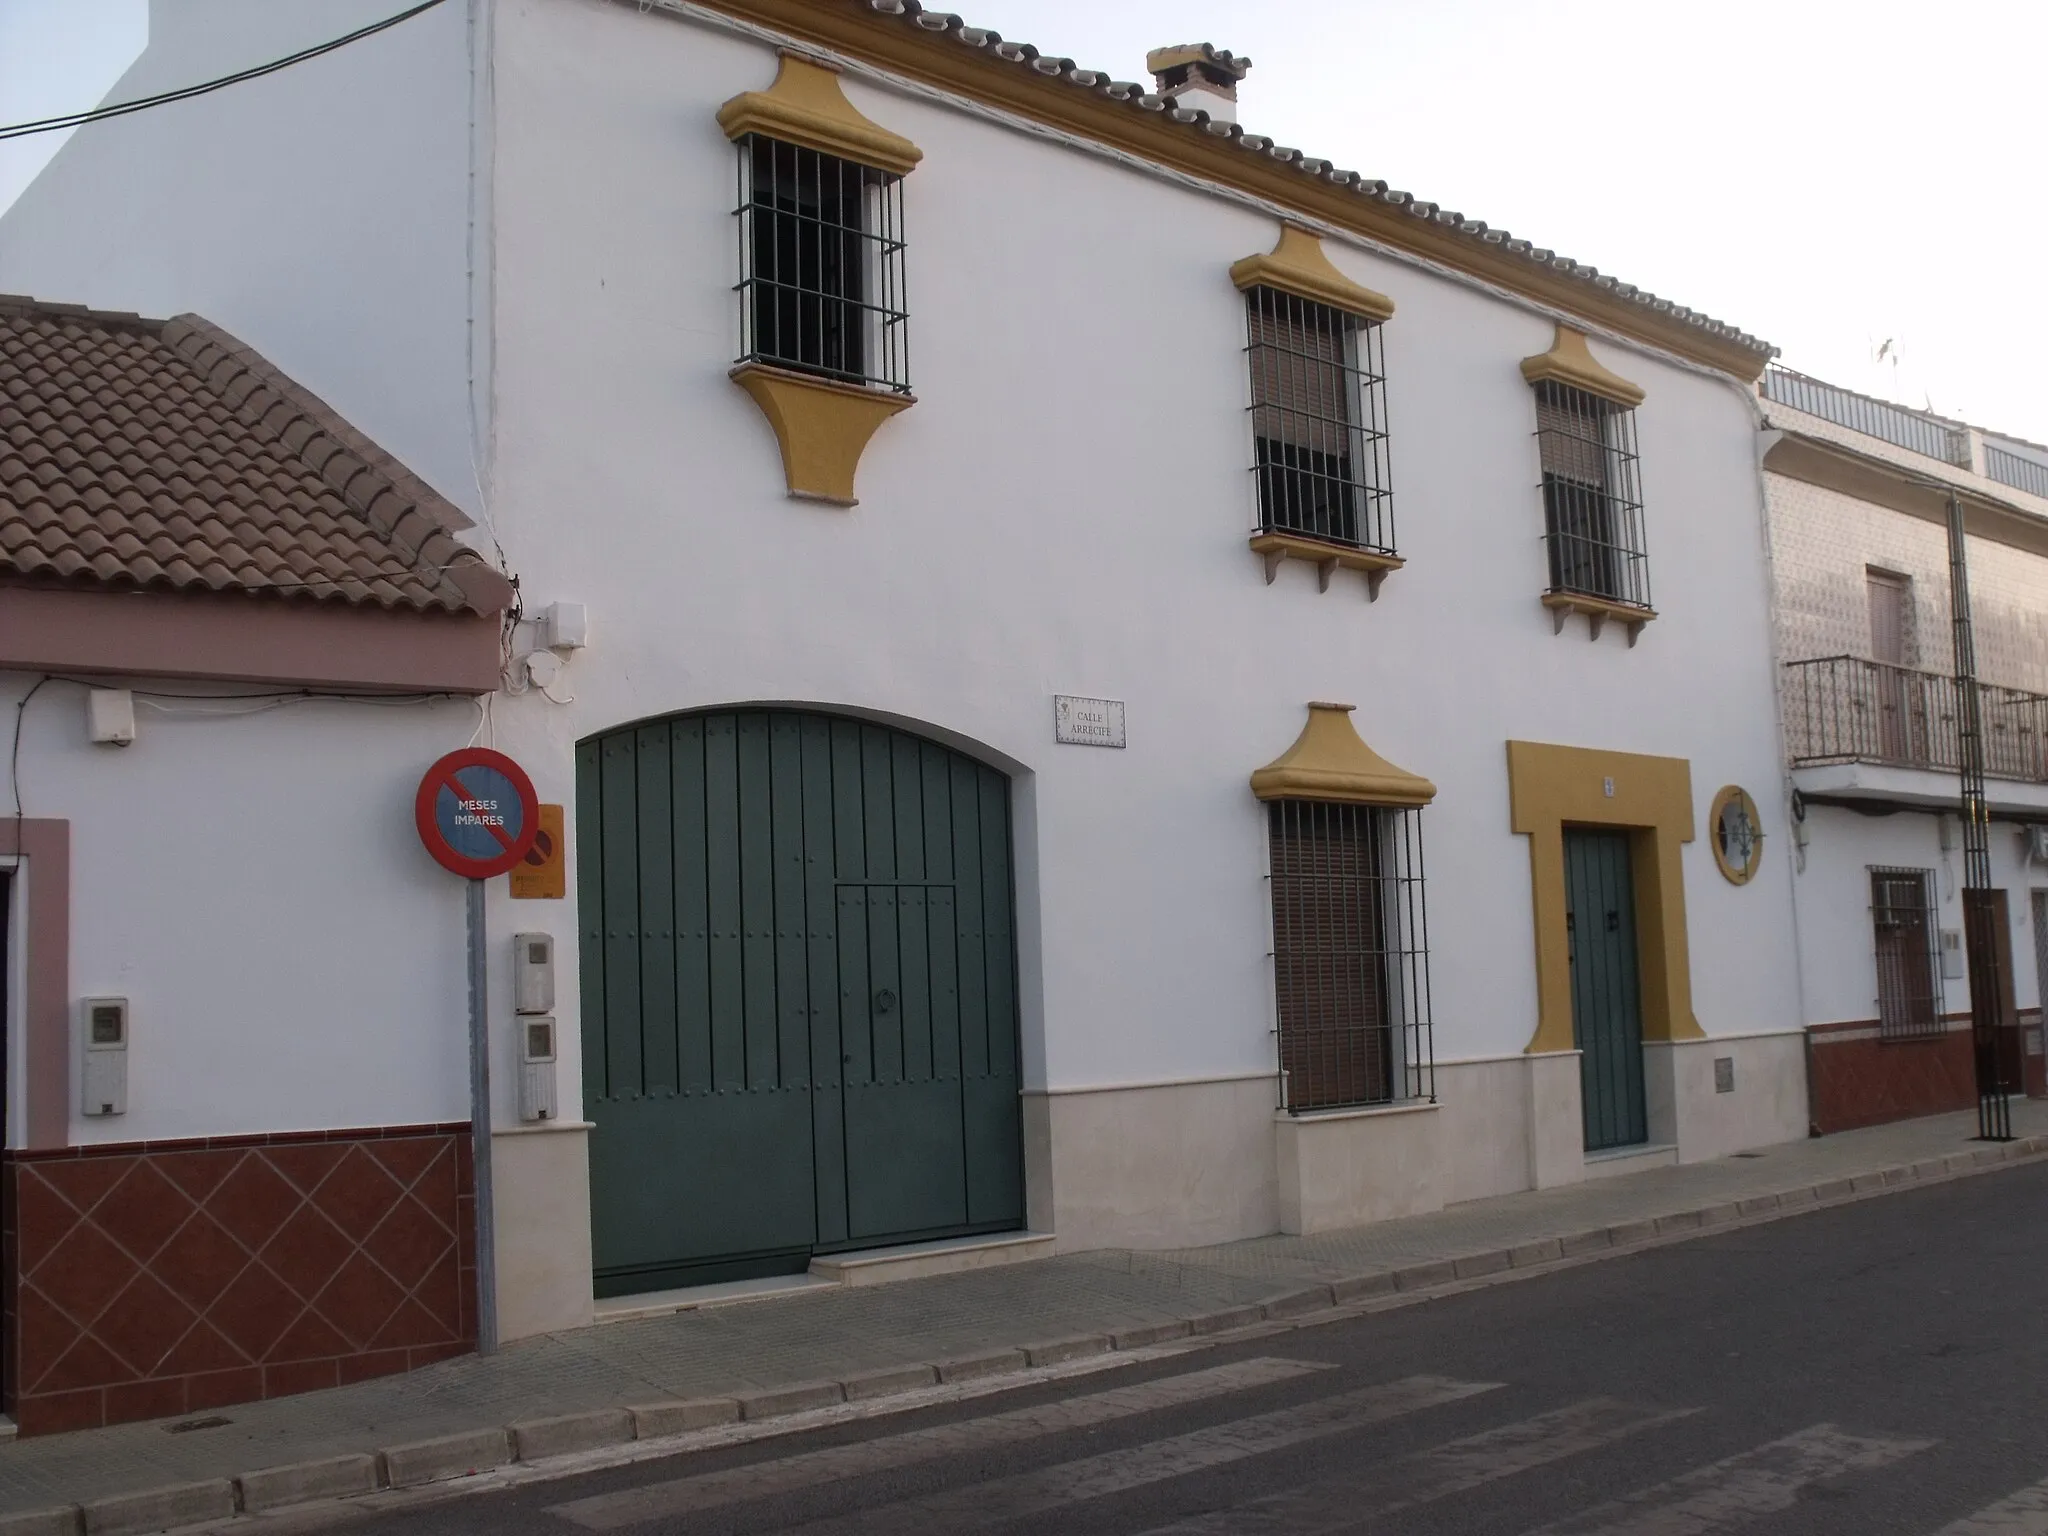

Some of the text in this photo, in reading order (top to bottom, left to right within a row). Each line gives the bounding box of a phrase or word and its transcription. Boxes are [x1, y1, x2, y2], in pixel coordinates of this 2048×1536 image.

[1077, 712, 1103, 722] CALLE
[1071, 724, 1112, 737] ARRECIFE
[458, 800, 498, 811] MESES
[455, 815, 504, 826] IMPARES
